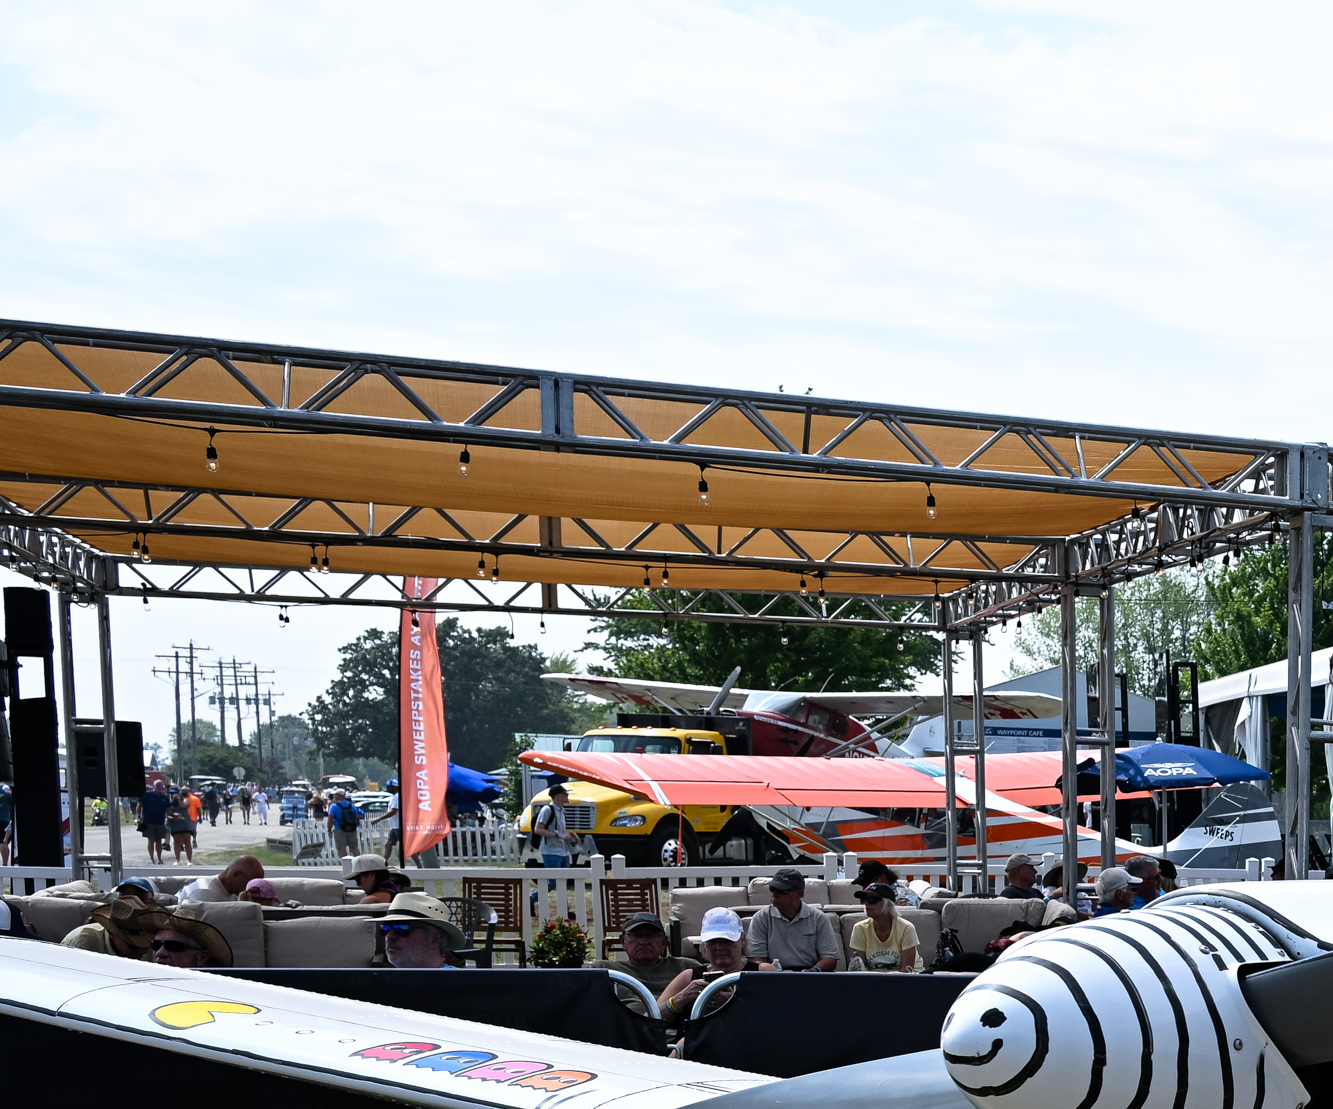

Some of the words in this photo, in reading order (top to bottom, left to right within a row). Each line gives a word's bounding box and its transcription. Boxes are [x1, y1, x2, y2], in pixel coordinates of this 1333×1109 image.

[410, 650, 428, 765] SWEEPSTAKES
[996, 729, 1027, 737] WAYPOINT
[1143, 766, 1198, 777] AOPA
[417, 769, 432, 812] AOPA
[1203, 824, 1235, 842] SWEEPS
